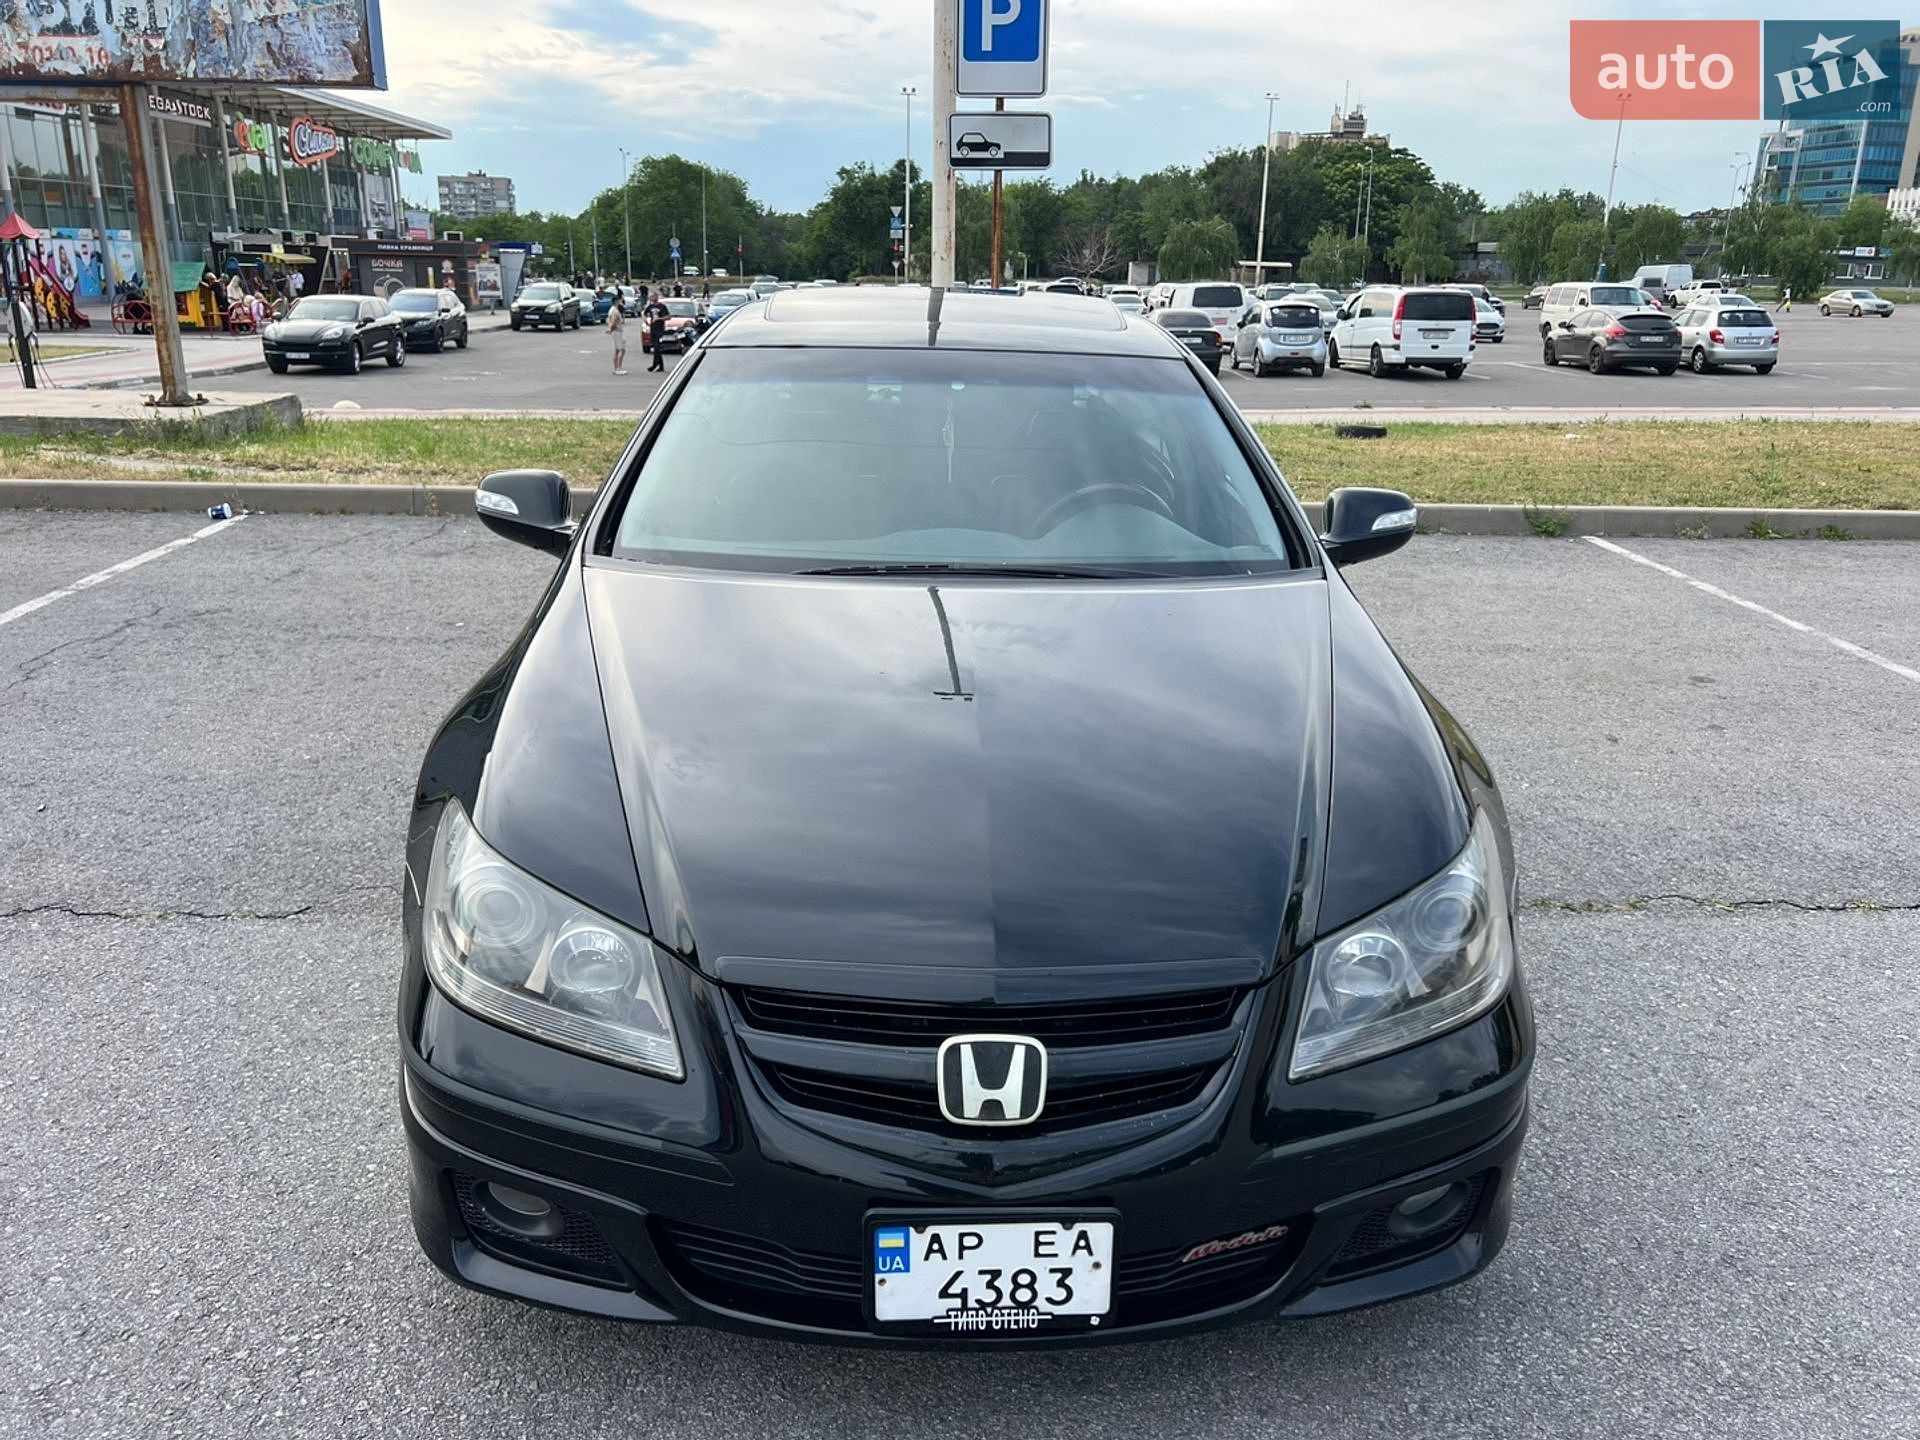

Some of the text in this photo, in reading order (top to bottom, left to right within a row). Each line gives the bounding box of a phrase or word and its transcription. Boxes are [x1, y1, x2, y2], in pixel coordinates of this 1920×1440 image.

[982, 0, 1021, 51] P
[923, 1230, 1094, 1261] AP EA
[878, 1256, 905, 1272] UA
[938, 1267, 1074, 1308] 4383
